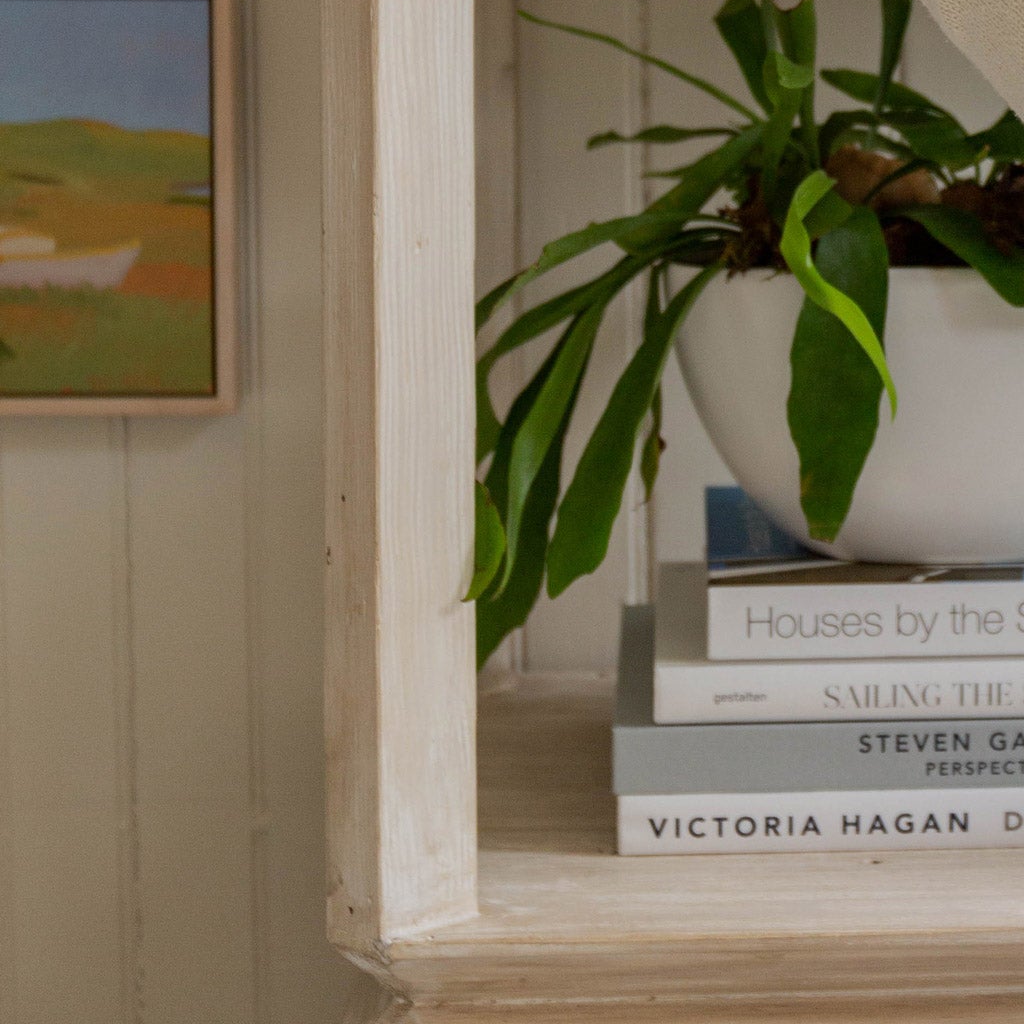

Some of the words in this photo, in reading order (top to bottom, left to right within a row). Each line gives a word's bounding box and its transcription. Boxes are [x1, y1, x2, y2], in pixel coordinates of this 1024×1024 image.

[745, 606, 884, 639] Houses
[896, 602, 939, 644] by
[949, 602, 1005, 636] the
[712, 691, 768, 706] gestalten
[823, 683, 942, 709] SAILING
[952, 681, 1013, 707] THE
[858, 732, 971, 754] STEVEN
[648, 815, 822, 839] VICTORIA
[841, 812, 970, 836] HAGAN
